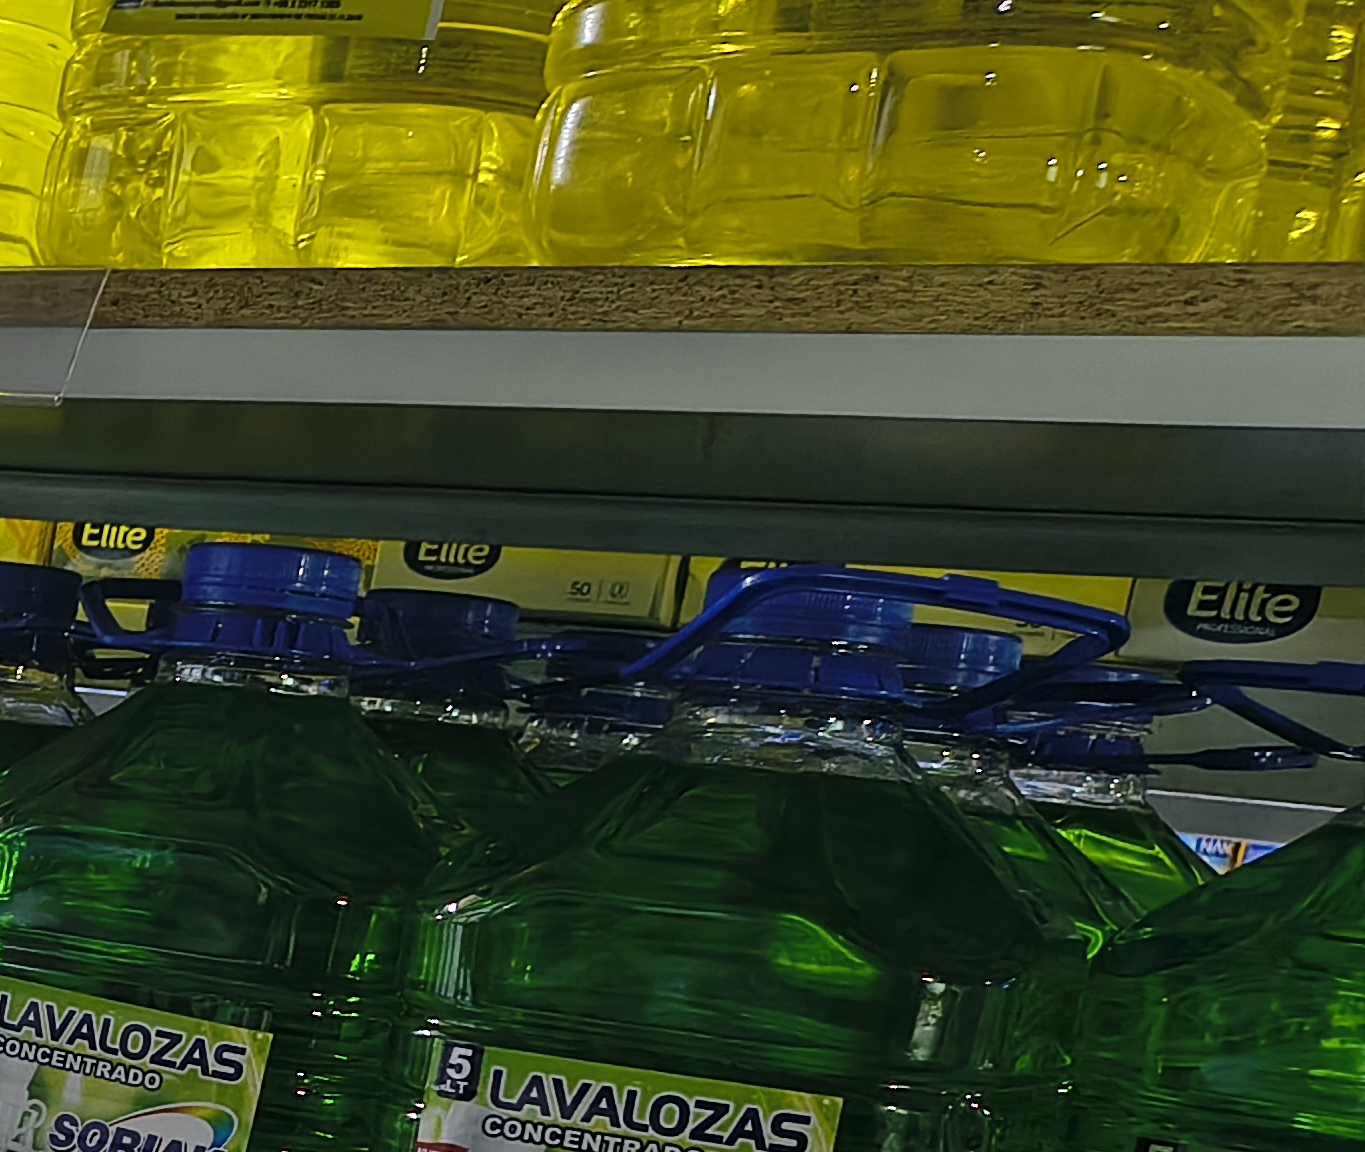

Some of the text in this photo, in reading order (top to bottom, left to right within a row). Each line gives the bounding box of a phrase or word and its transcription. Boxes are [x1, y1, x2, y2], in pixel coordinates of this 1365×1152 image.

[81, 521, 147, 550] Elite
[418, 541, 490, 565] Elite
[569, 580, 591, 597] 50
[1186, 580, 1300, 624] Elite
[445, 1046, 473, 1080] 5
[446, 1079, 468, 1094] LT
